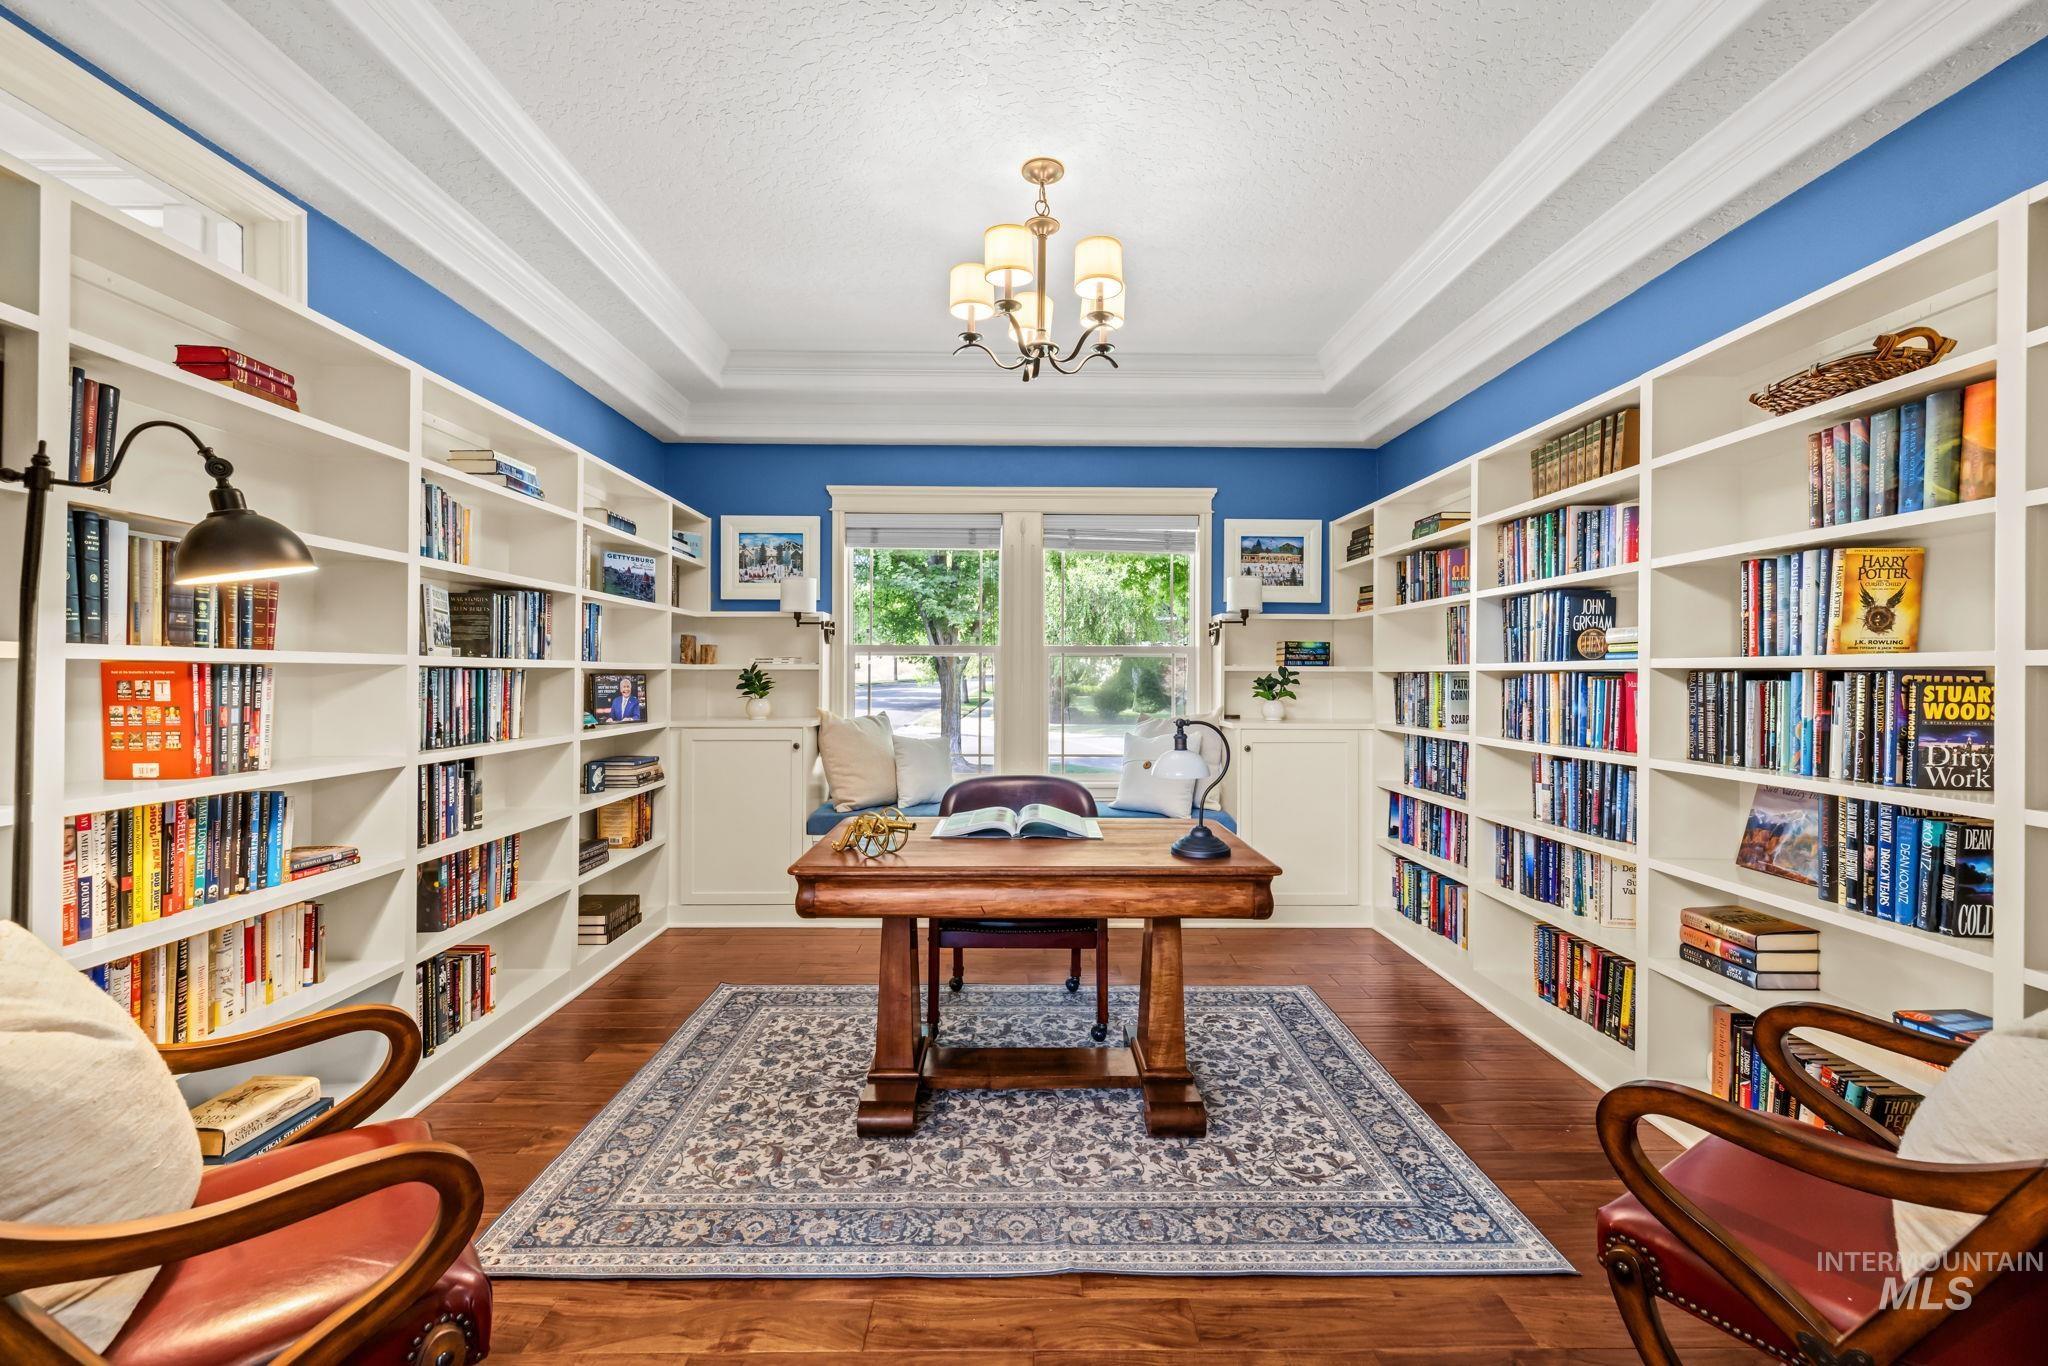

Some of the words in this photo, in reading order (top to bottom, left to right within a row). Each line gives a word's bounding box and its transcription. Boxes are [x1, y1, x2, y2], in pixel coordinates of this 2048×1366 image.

[1825, 445, 1833, 473] HARRY
[607, 553, 654, 564] GETTYSBURG
[1862, 555, 1910, 568] HARRY
[1835, 565, 1843, 590] HARRY
[1858, 568, 1911, 580] POTTER
[1581, 599, 1605, 615] JOHN
[1834, 592, 1842, 618] POTTER
[1573, 615, 1613, 631] GRISHAM
[232, 667, 240, 685] Killing
[232, 687, 240, 705] Patton
[1451, 690, 1469, 700] CORN
[1926, 745, 1994, 772] Dirty
[1924, 766, 1991, 788] Work
[1781, 788, 1806, 800] Valley
[178, 801, 186, 818] TOM
[198, 801, 207, 825] JAMES
[1881, 804, 1892, 820] DEAN
[177, 821, 185, 854] SELLECK
[1880, 821, 1892, 843] KOONTZ
[1965, 829, 1993, 850] DEAN
[196, 828, 206, 878] LONGSTREET
[1899, 843, 1910, 868] DEAN
[1920, 824, 1933, 871] KOONTZ
[1821, 852, 1829, 873] ashley
[1880, 848, 1890, 880] DRAGON
[1880, 881, 1890, 906] TEARS
[1898, 870, 1909, 904] KOONTZ
[81, 882, 89, 918] JOURNEY
[1683, 947, 1703, 958] REBECCA
[1725, 952, 1743, 964] FLAME
[1729, 948, 1740, 956] IRON
[1726, 971, 1744, 981] STORM
[1728, 966, 1742, 975] ONYX
[1613, 994, 1621, 1015] CAUSE
[1719, 1017, 1727, 1058] elizabeth
[1717, 1060, 1725, 1091] george
